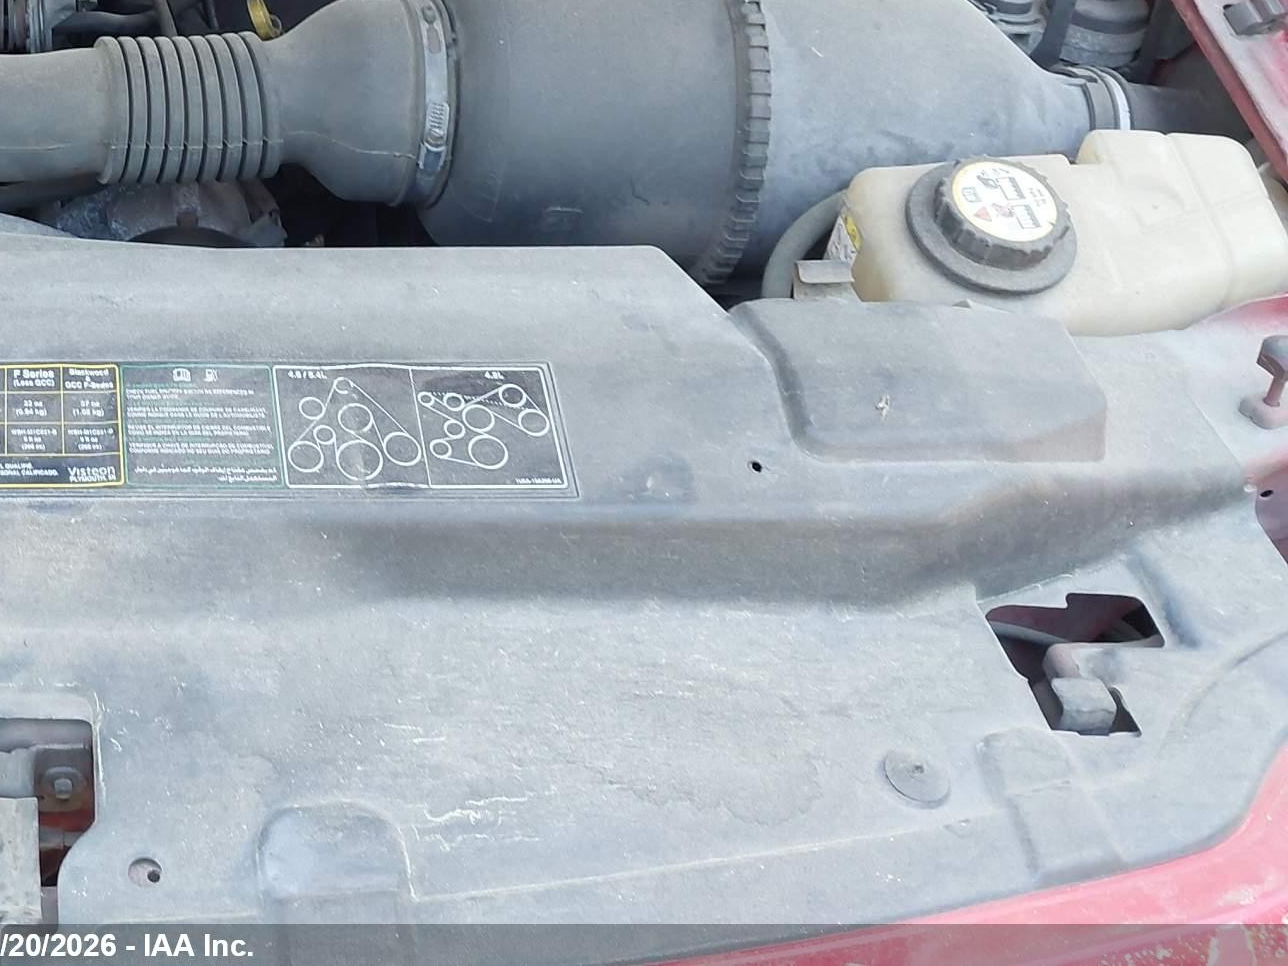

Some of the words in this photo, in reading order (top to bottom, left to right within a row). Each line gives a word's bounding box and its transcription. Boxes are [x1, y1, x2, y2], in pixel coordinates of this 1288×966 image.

[13, 369, 21, 379] F
[22, 369, 55, 379] Series
[67, 466, 116, 476] Visteon
